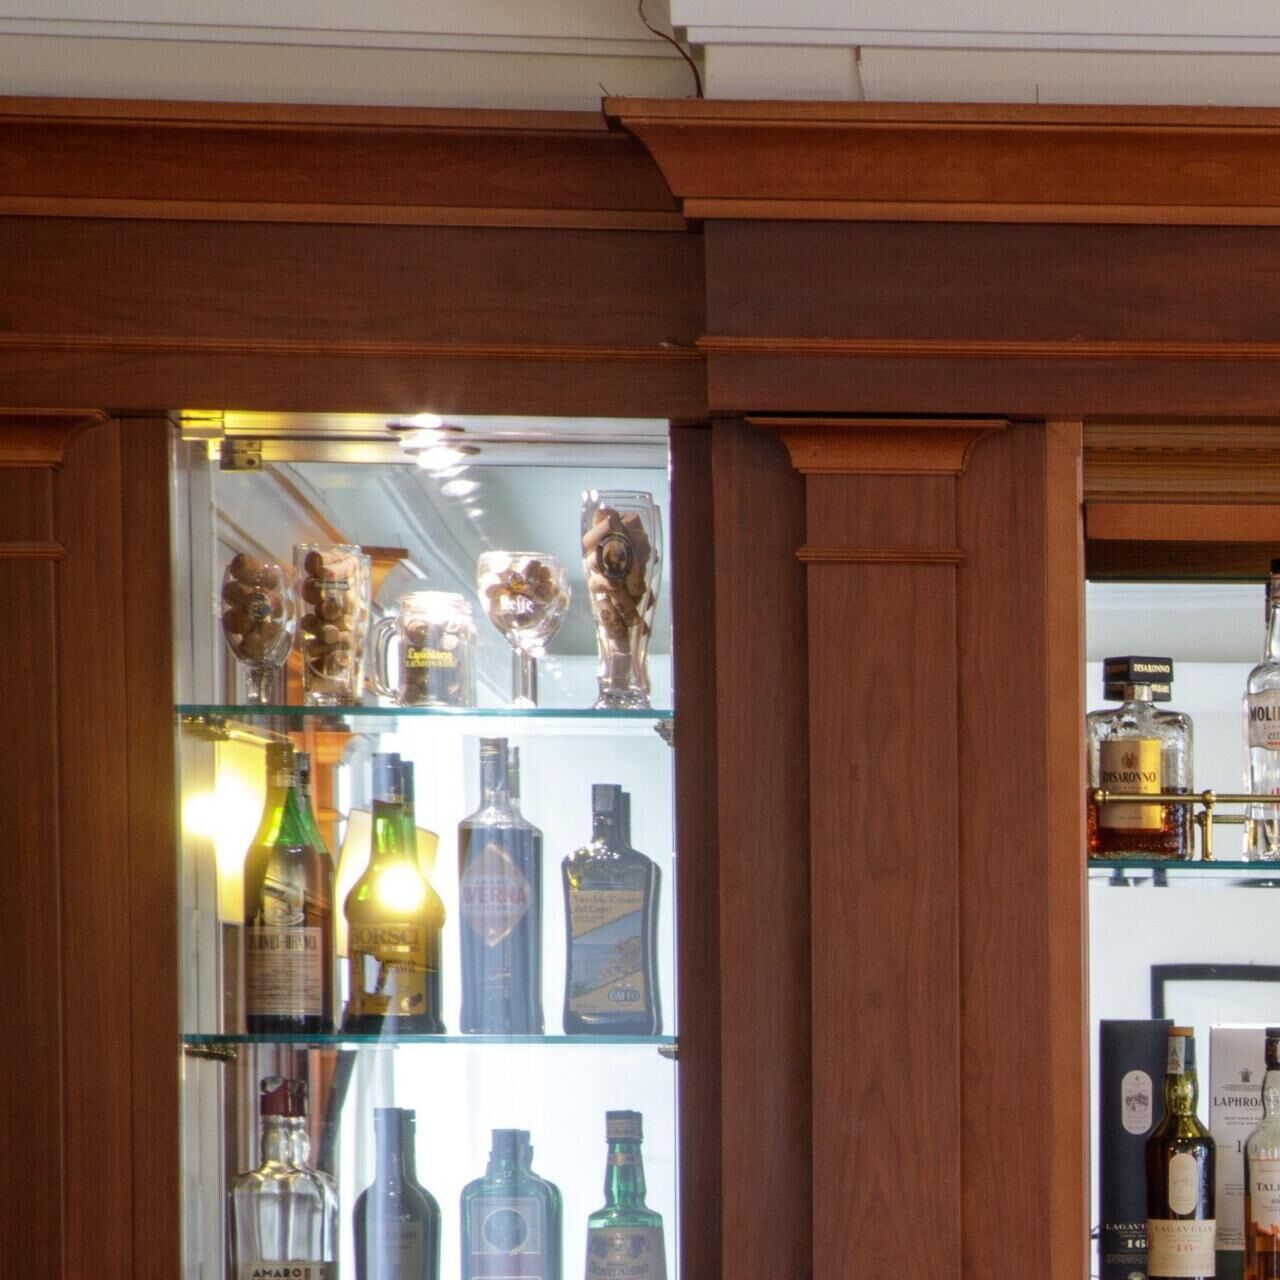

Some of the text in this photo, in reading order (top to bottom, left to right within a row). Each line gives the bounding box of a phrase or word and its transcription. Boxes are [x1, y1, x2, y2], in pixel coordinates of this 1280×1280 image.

[1103, 772, 1156, 783] DISARONNO
[1213, 1096, 1263, 1107] LAPHRO
[1106, 1223, 1146, 1231] LAGAV
[1127, 1239, 1146, 1249] 16
[253, 1268, 302, 1278] AMARO
